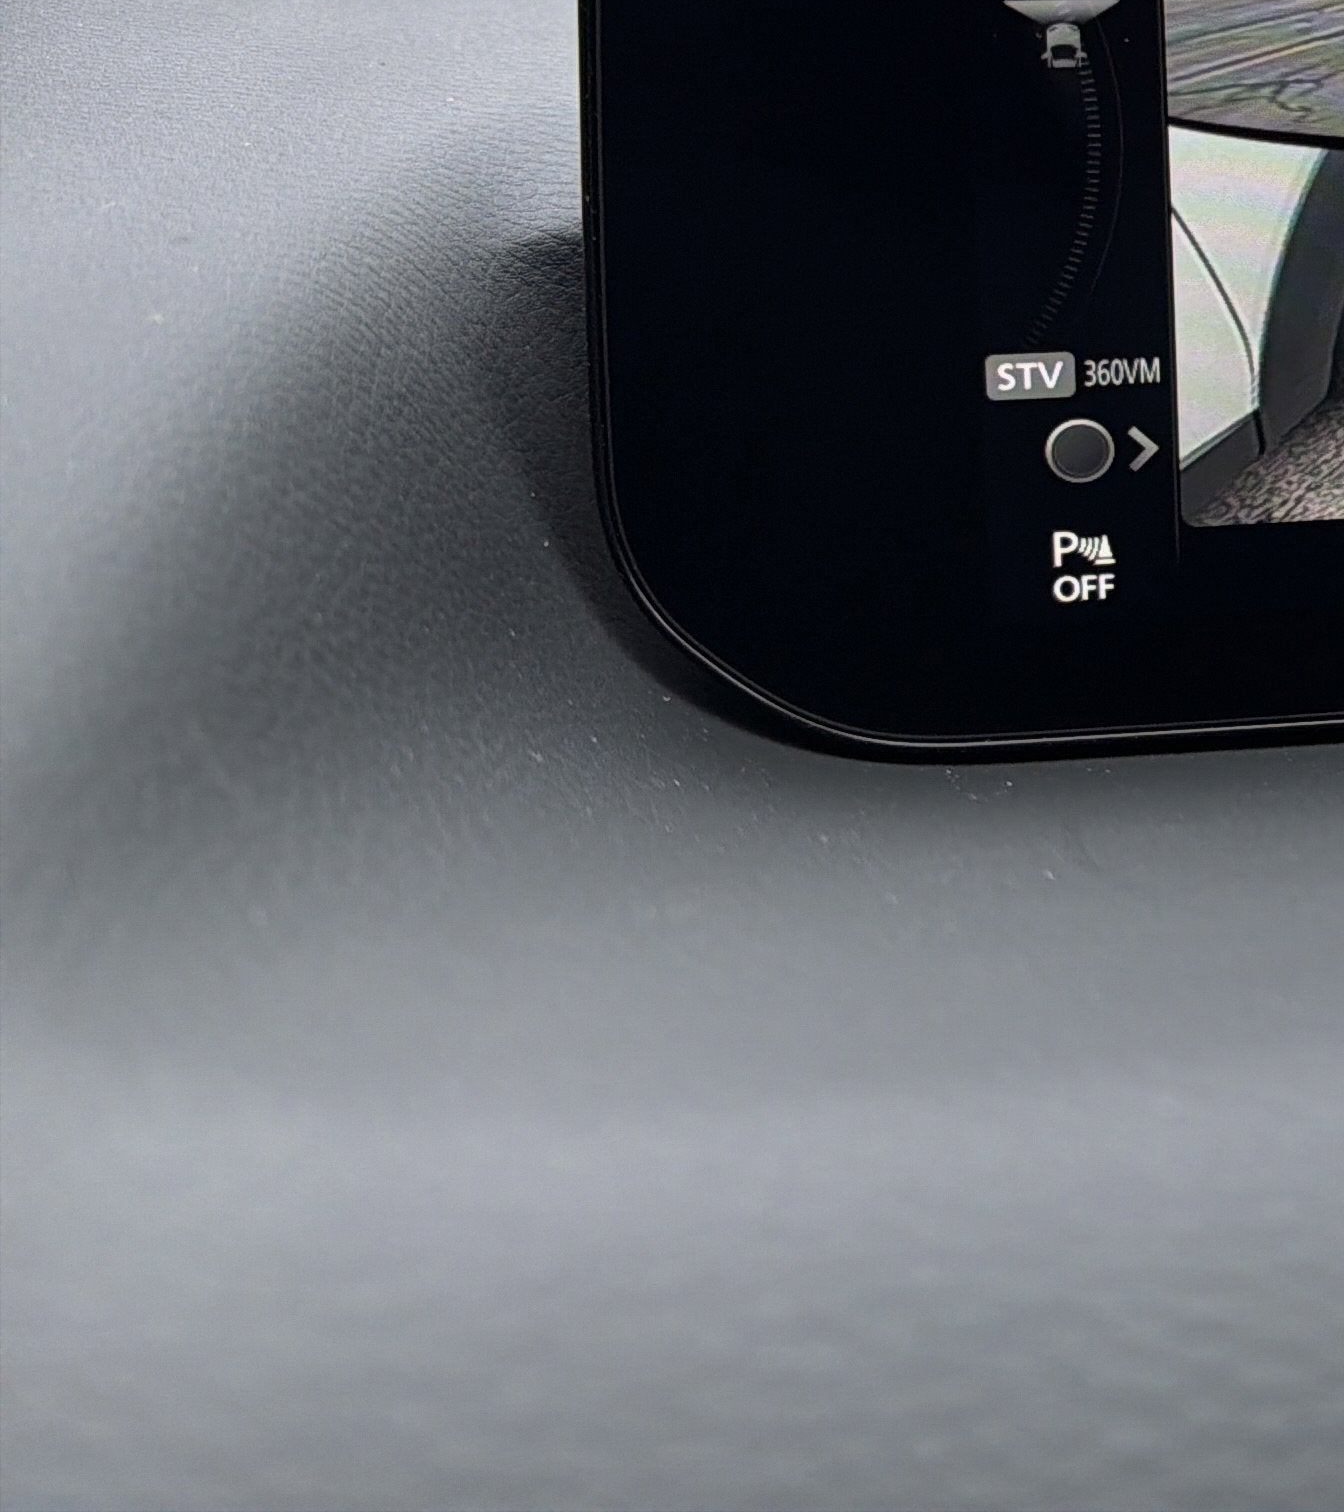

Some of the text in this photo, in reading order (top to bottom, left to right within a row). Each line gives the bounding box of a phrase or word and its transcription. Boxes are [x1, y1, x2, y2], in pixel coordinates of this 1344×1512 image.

[997, 356, 1161, 391] STV 360VM
[1052, 530, 1080, 568] P
[1052, 573, 1116, 603] OFF
